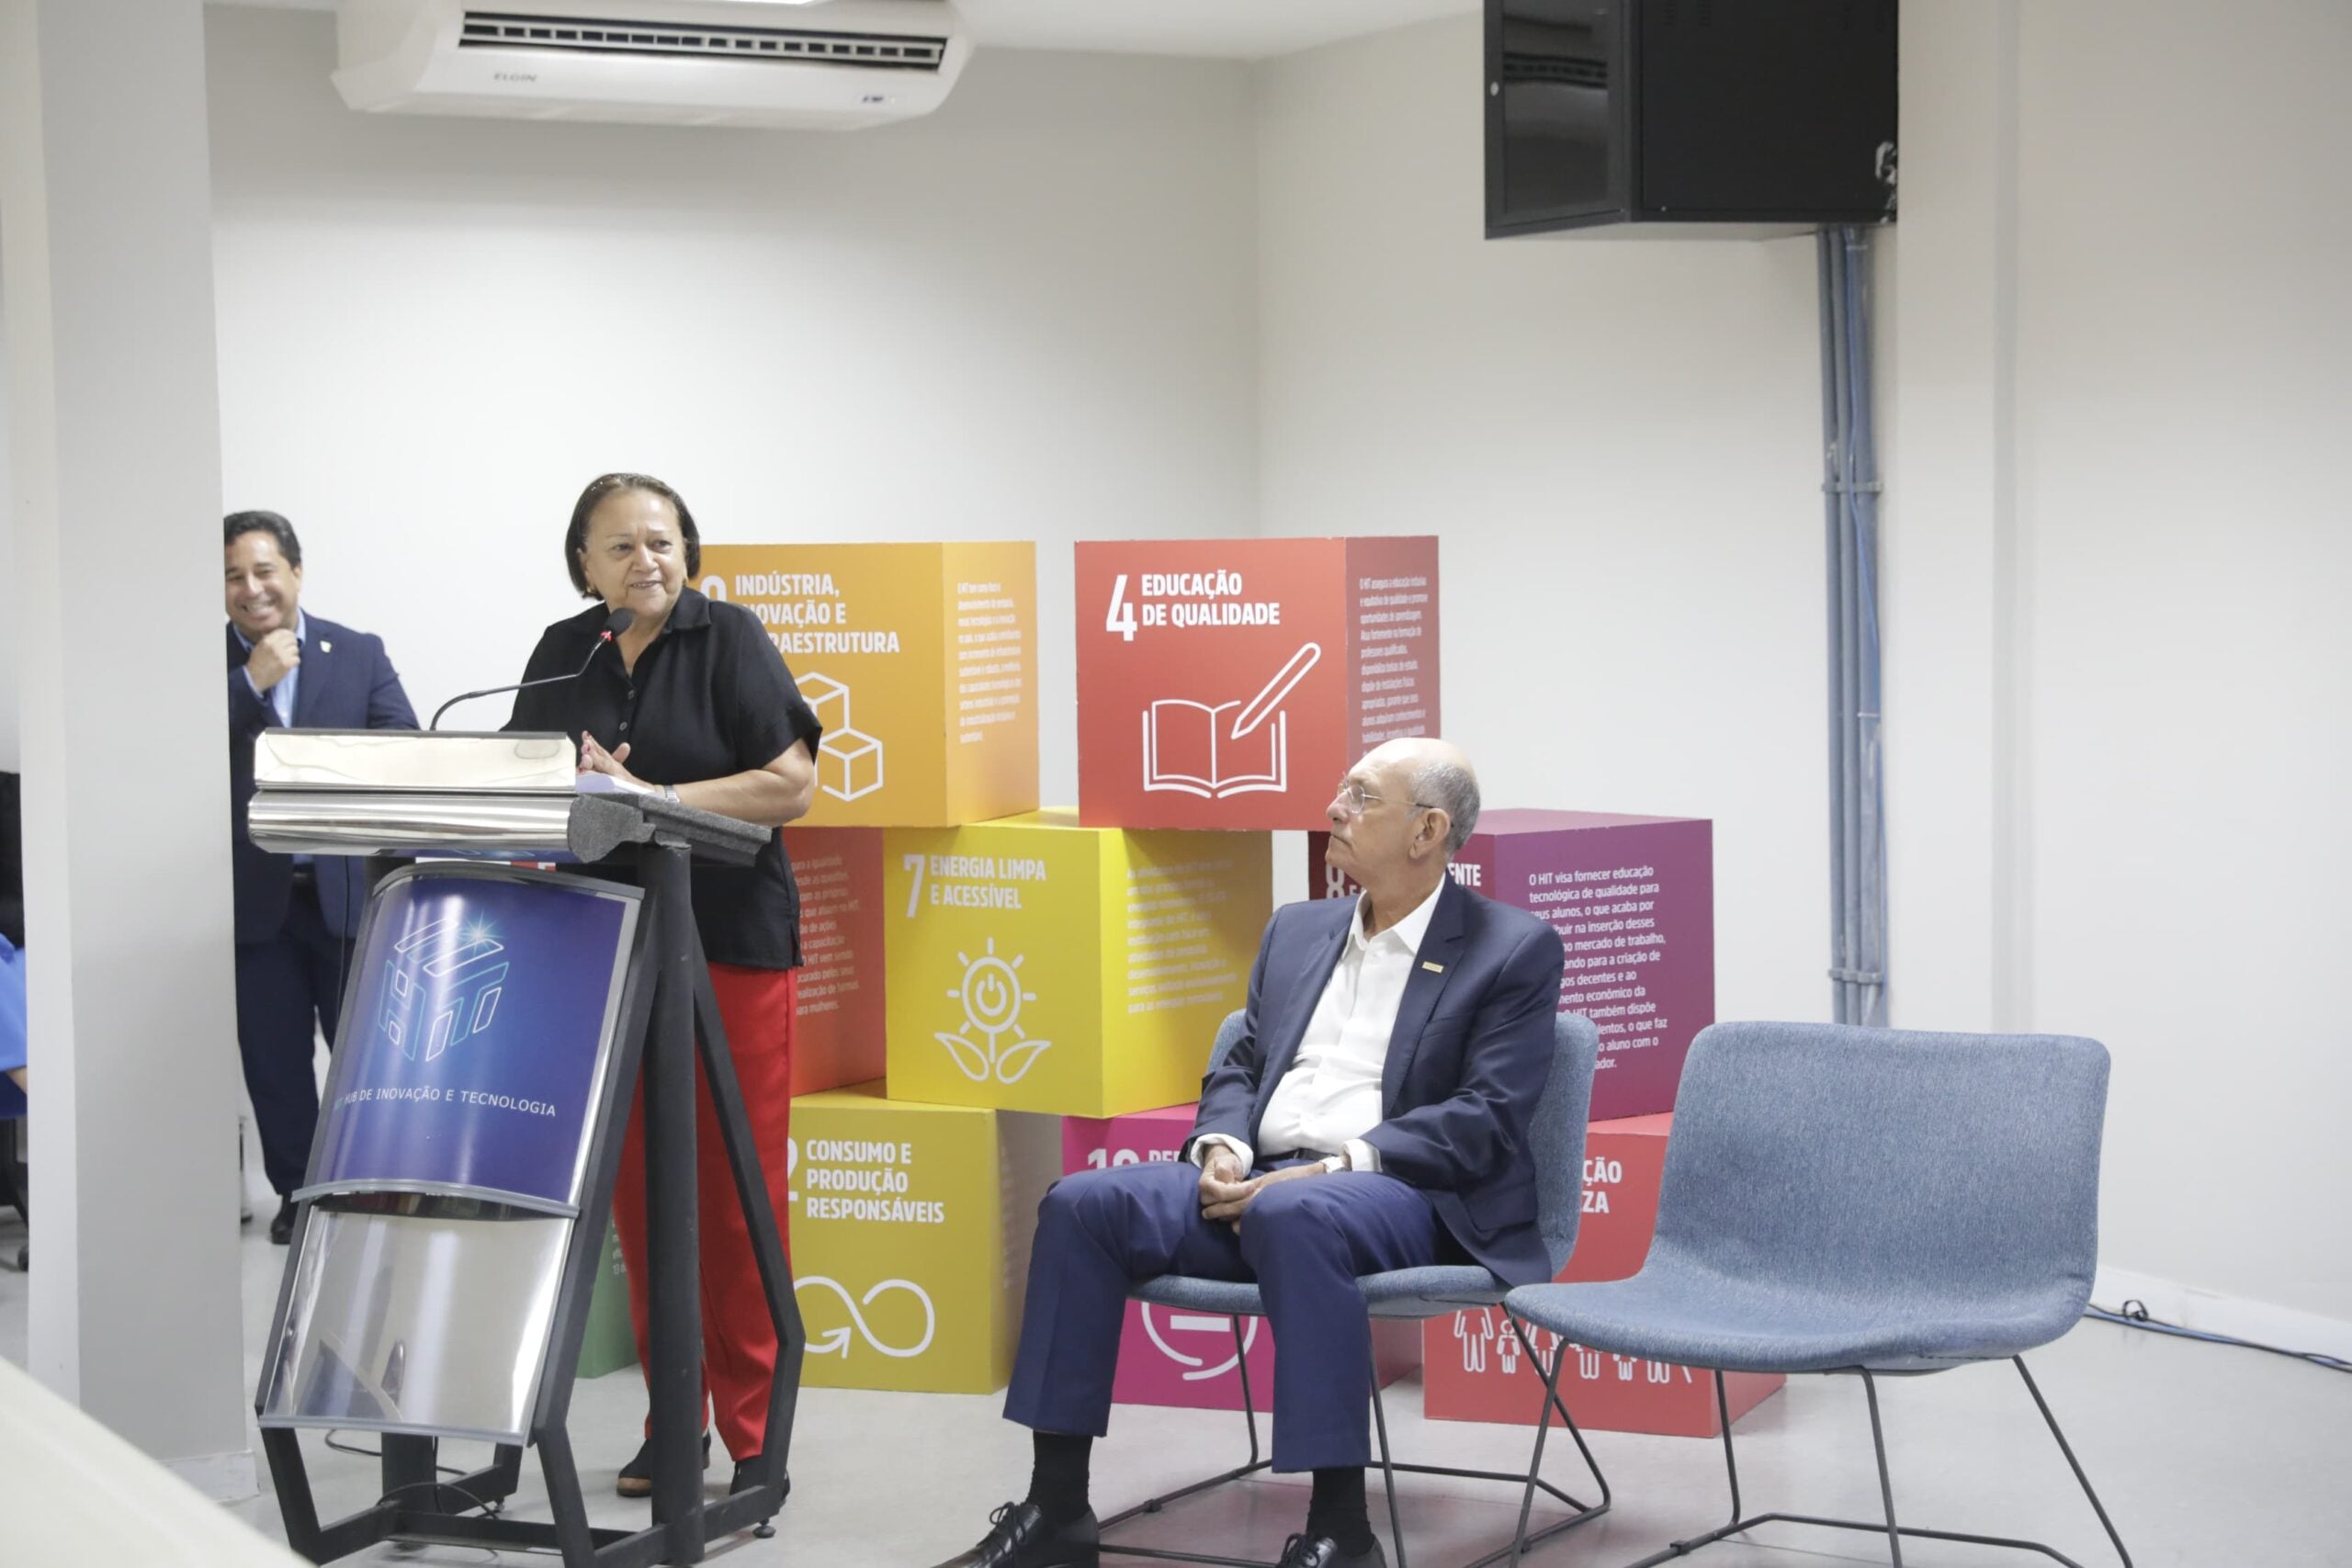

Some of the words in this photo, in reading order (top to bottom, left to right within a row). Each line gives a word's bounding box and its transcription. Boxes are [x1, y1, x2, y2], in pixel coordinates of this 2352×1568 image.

[735, 570, 840, 597] INDÚSTRIA,
[1141, 570, 1243, 600] EDUCAÇÃO
[835, 604, 846, 625] E
[1106, 574, 1137, 641] 4
[1142, 604, 1167, 626] DE
[1171, 603, 1281, 628] QUALIDADE
[930, 855, 995, 878] ENERGIA
[999, 858, 1046, 881] LIMPA
[1529, 874, 1536, 886] O
[1538, 873, 1553, 885] HIT
[1555, 873, 1572, 884] visa
[1575, 870, 1611, 882] fornecer
[1612, 865, 1654, 880] educação
[903, 854, 925, 919] 7
[931, 884, 940, 905] E
[944, 883, 1022, 909] ACESSÍVEL
[1530, 888, 1580, 903] tecnológica
[1582, 887, 1593, 899] de
[1595, 883, 1638, 899] qualidade
[1639, 883, 1659, 896] para
[1552, 907, 1583, 919] alunos,
[1585, 906, 1591, 916] o
[1593, 904, 1610, 917] que
[1611, 900, 1637, 914] acaba
[1639, 900, 1655, 913] por
[1575, 924, 1587, 934] na
[1588, 919, 1624, 933] inserção
[1625, 918, 1656, 930] desses
[1574, 938, 1612, 951] mercado
[1614, 936, 1626, 947] de
[1627, 932, 1666, 947] trabalho,
[1588, 956, 1607, 969] para
[1609, 955, 1615, 965] a
[1617, 952, 1647, 966] criação
[1649, 950, 1660, 961] de
[1577, 973, 1616, 986] decentes
[1618, 972, 1623, 982] e
[1625, 970, 1636, 980] ao
[1586, 987, 1633, 1001] econômico
[1634, 985, 1645, 997] da
[1589, 1005, 1625, 1019] também
[1627, 1001, 1657, 1015] dispõe
[1628, 1021, 1634, 1032] o
[1636, 1020, 1653, 1032] que
[1654, 1018, 1668, 1029] faz
[1607, 1039, 1631, 1052] aluno
[1633, 1037, 1651, 1049] com
[1653, 1036, 1659, 1046] o
[359, 1089, 373, 1101] DE
[376, 1086, 440, 1102] INOVAÇÃO
[446, 1089, 455, 1101] E
[460, 1090, 557, 1117] TECNOLOGIA
[807, 1139, 897, 1164] CONSUMO
[900, 1143, 912, 1164] E
[807, 1168, 909, 1195] PRODUÇÃO
[807, 1197, 944, 1224] RESPONSÁVEIS
